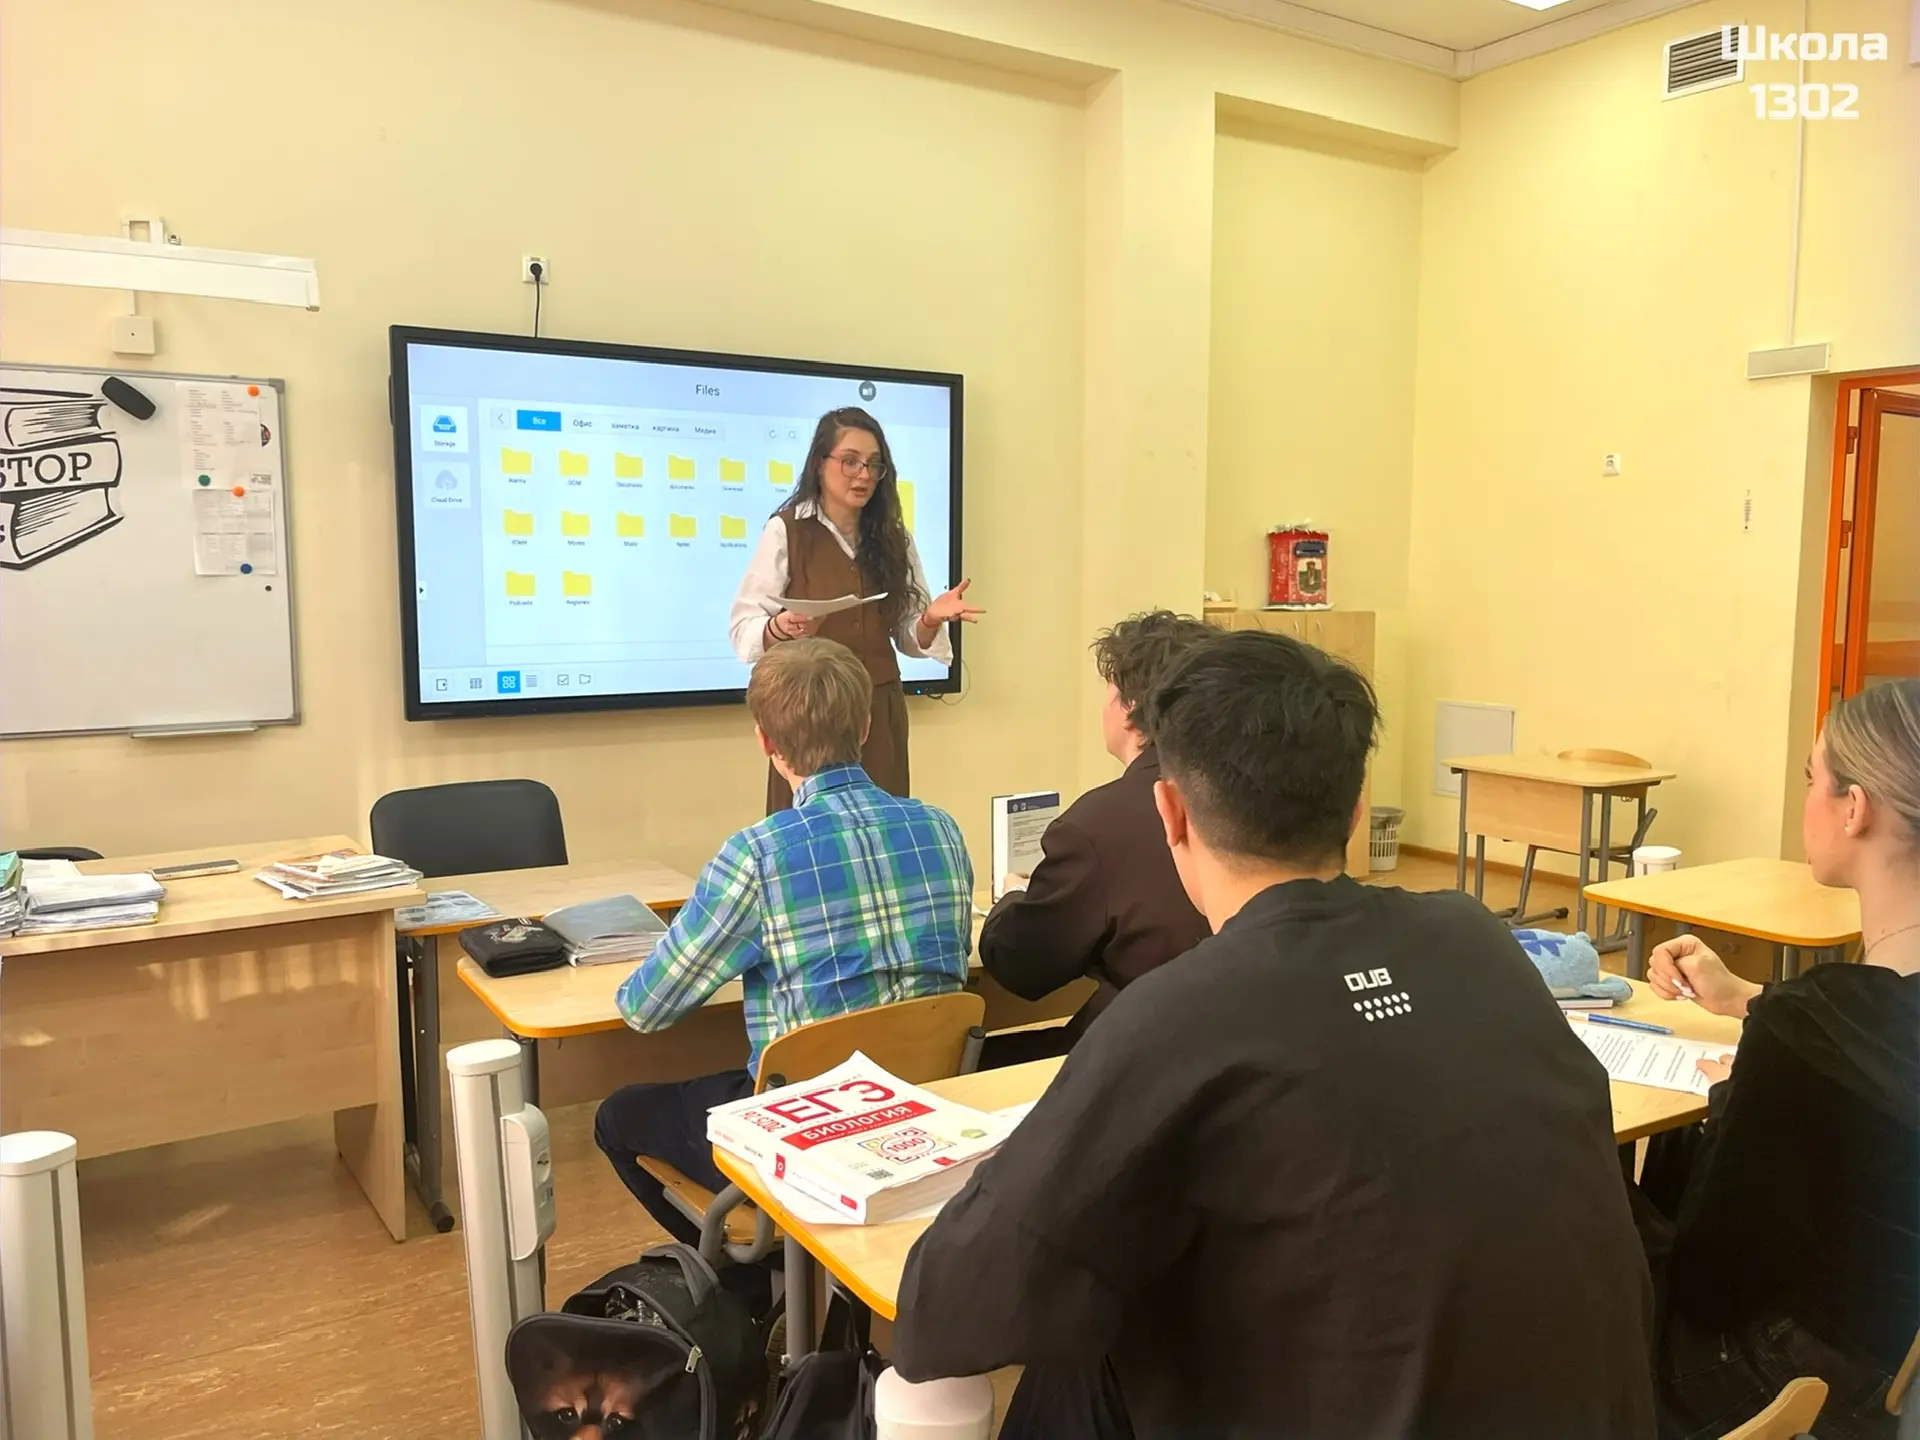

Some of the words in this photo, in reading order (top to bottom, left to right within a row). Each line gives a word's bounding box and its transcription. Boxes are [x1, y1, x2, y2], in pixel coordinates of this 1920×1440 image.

[695, 383, 720, 397] Files
[531, 415, 548, 427] Все
[572, 418, 593, 429] Офис
[611, 422, 640, 431] заметка
[434, 439, 456, 448] Storage
[763, 1080, 895, 1124] ЕГЭ
[801, 1106, 913, 1140] БИОЛОГИЯ
[886, 1137, 926, 1153] 1000
